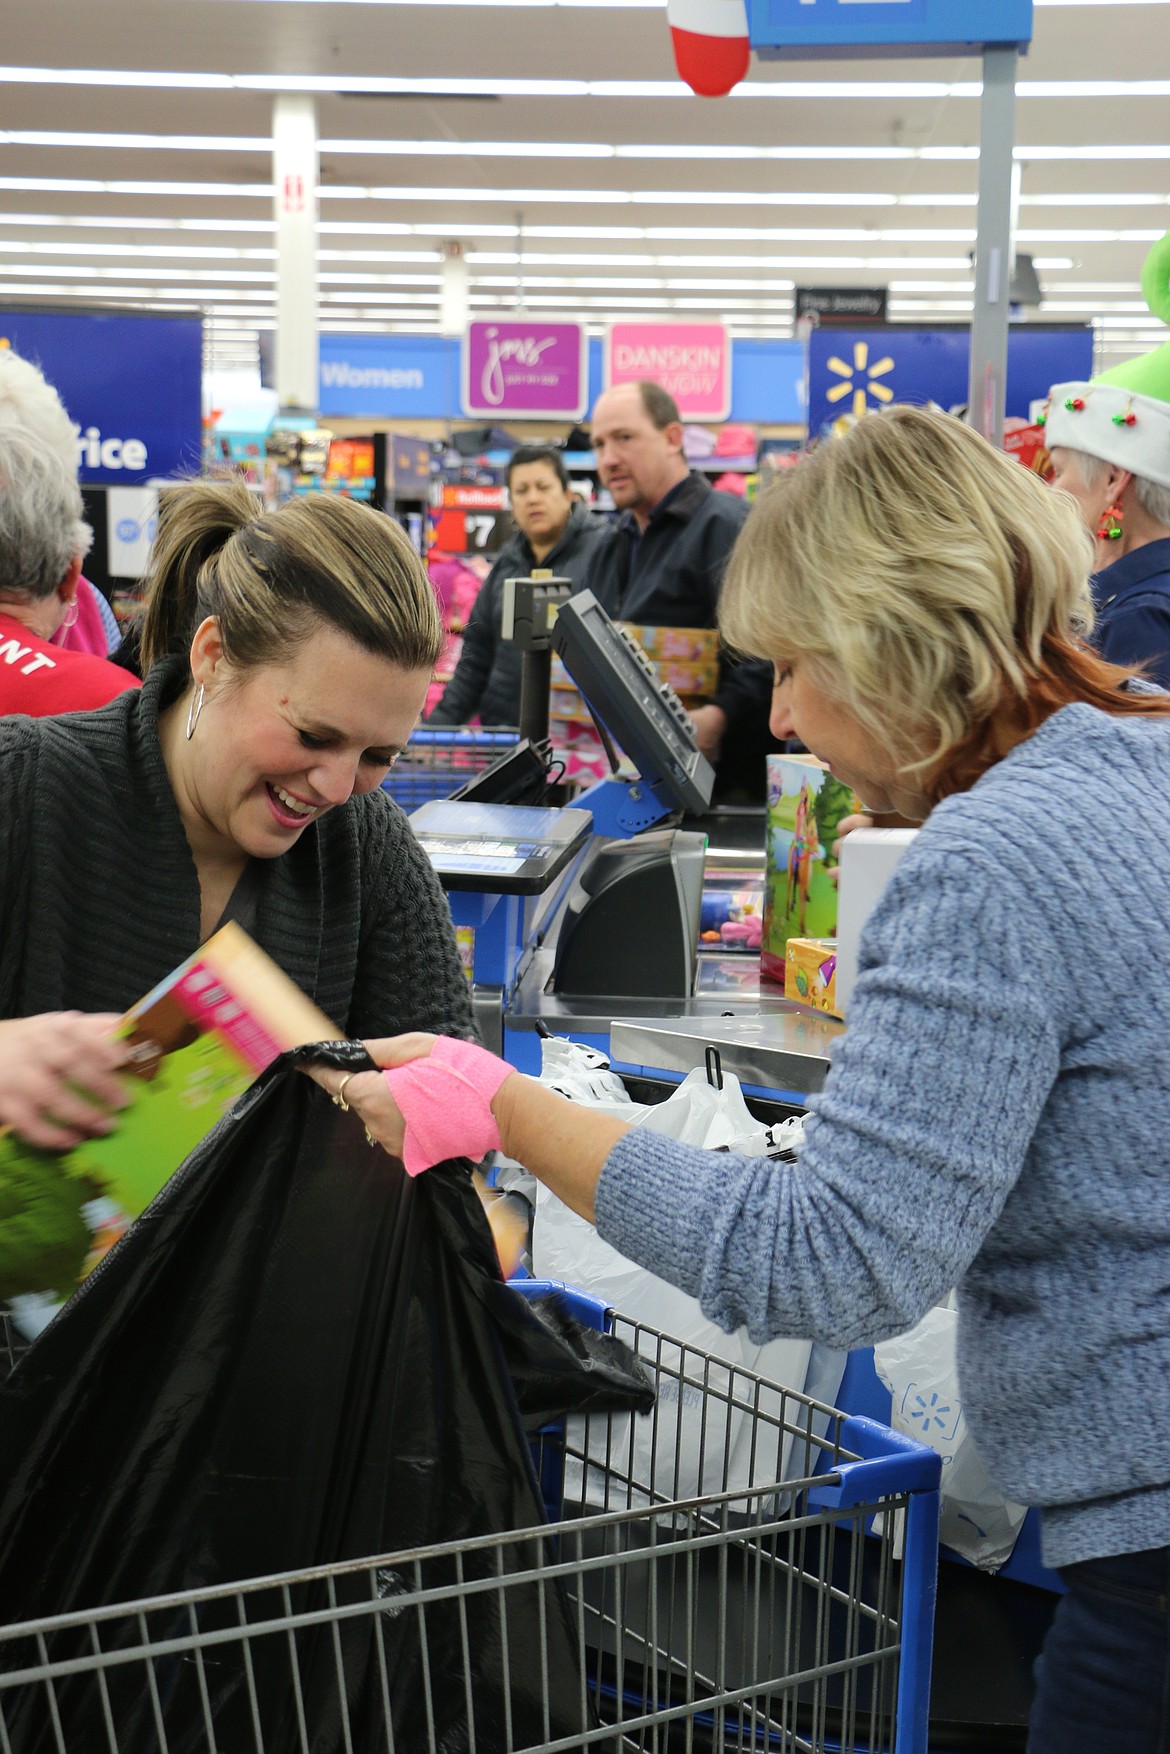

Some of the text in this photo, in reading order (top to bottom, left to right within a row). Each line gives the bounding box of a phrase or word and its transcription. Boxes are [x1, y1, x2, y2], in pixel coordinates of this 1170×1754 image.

[320, 362, 424, 389] Women
[614, 346, 721, 371] DANSKIN
[74, 427, 148, 470] rice
[0, 633, 57, 675] NT
